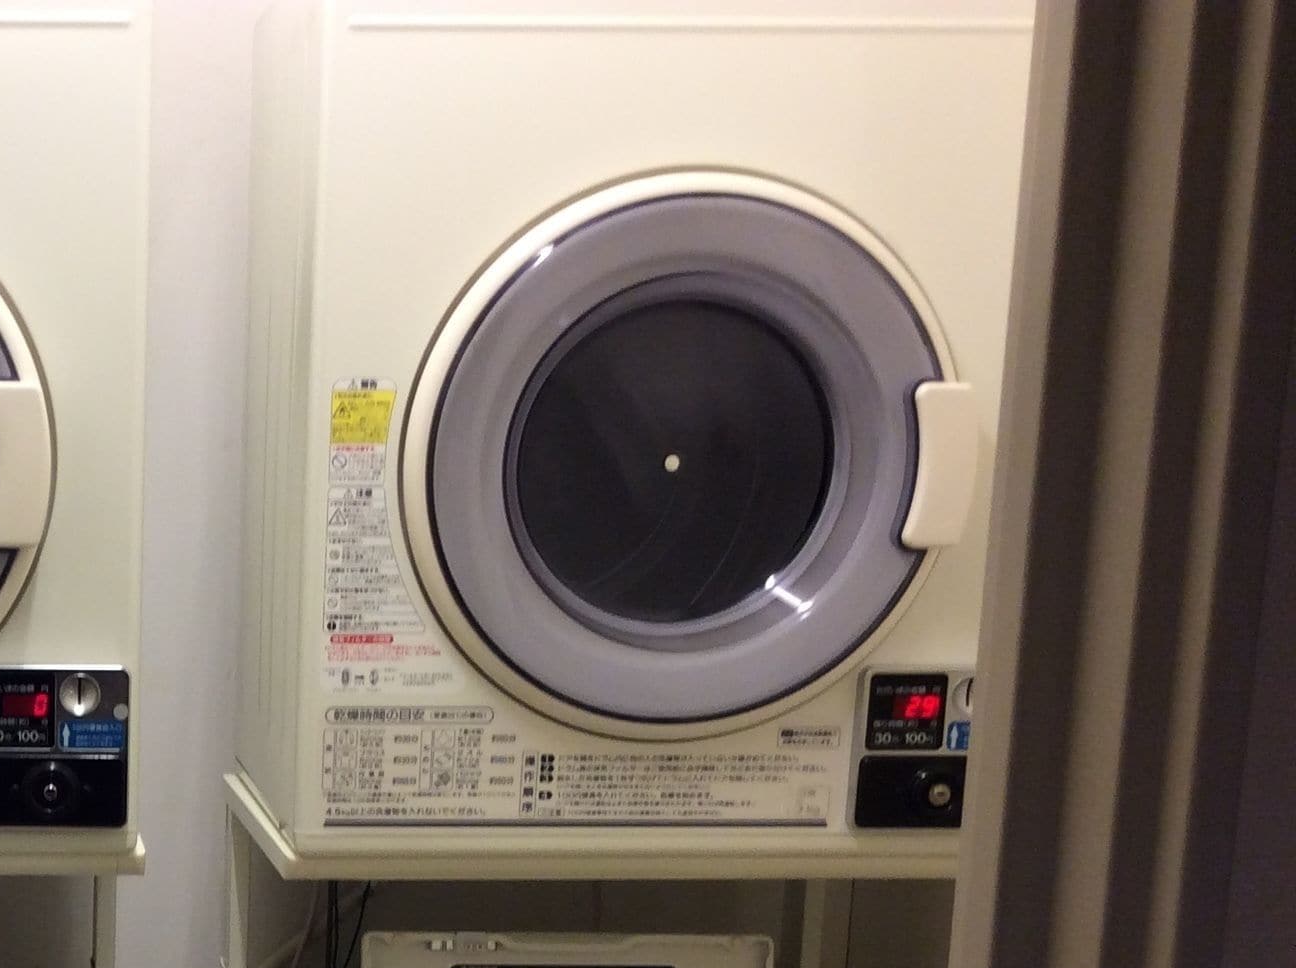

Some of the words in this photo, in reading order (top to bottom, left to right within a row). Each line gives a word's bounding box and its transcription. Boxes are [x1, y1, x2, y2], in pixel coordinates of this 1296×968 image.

[333, 708, 425, 723] 乾燥時間の目安
[904, 694, 941, 718] 29
